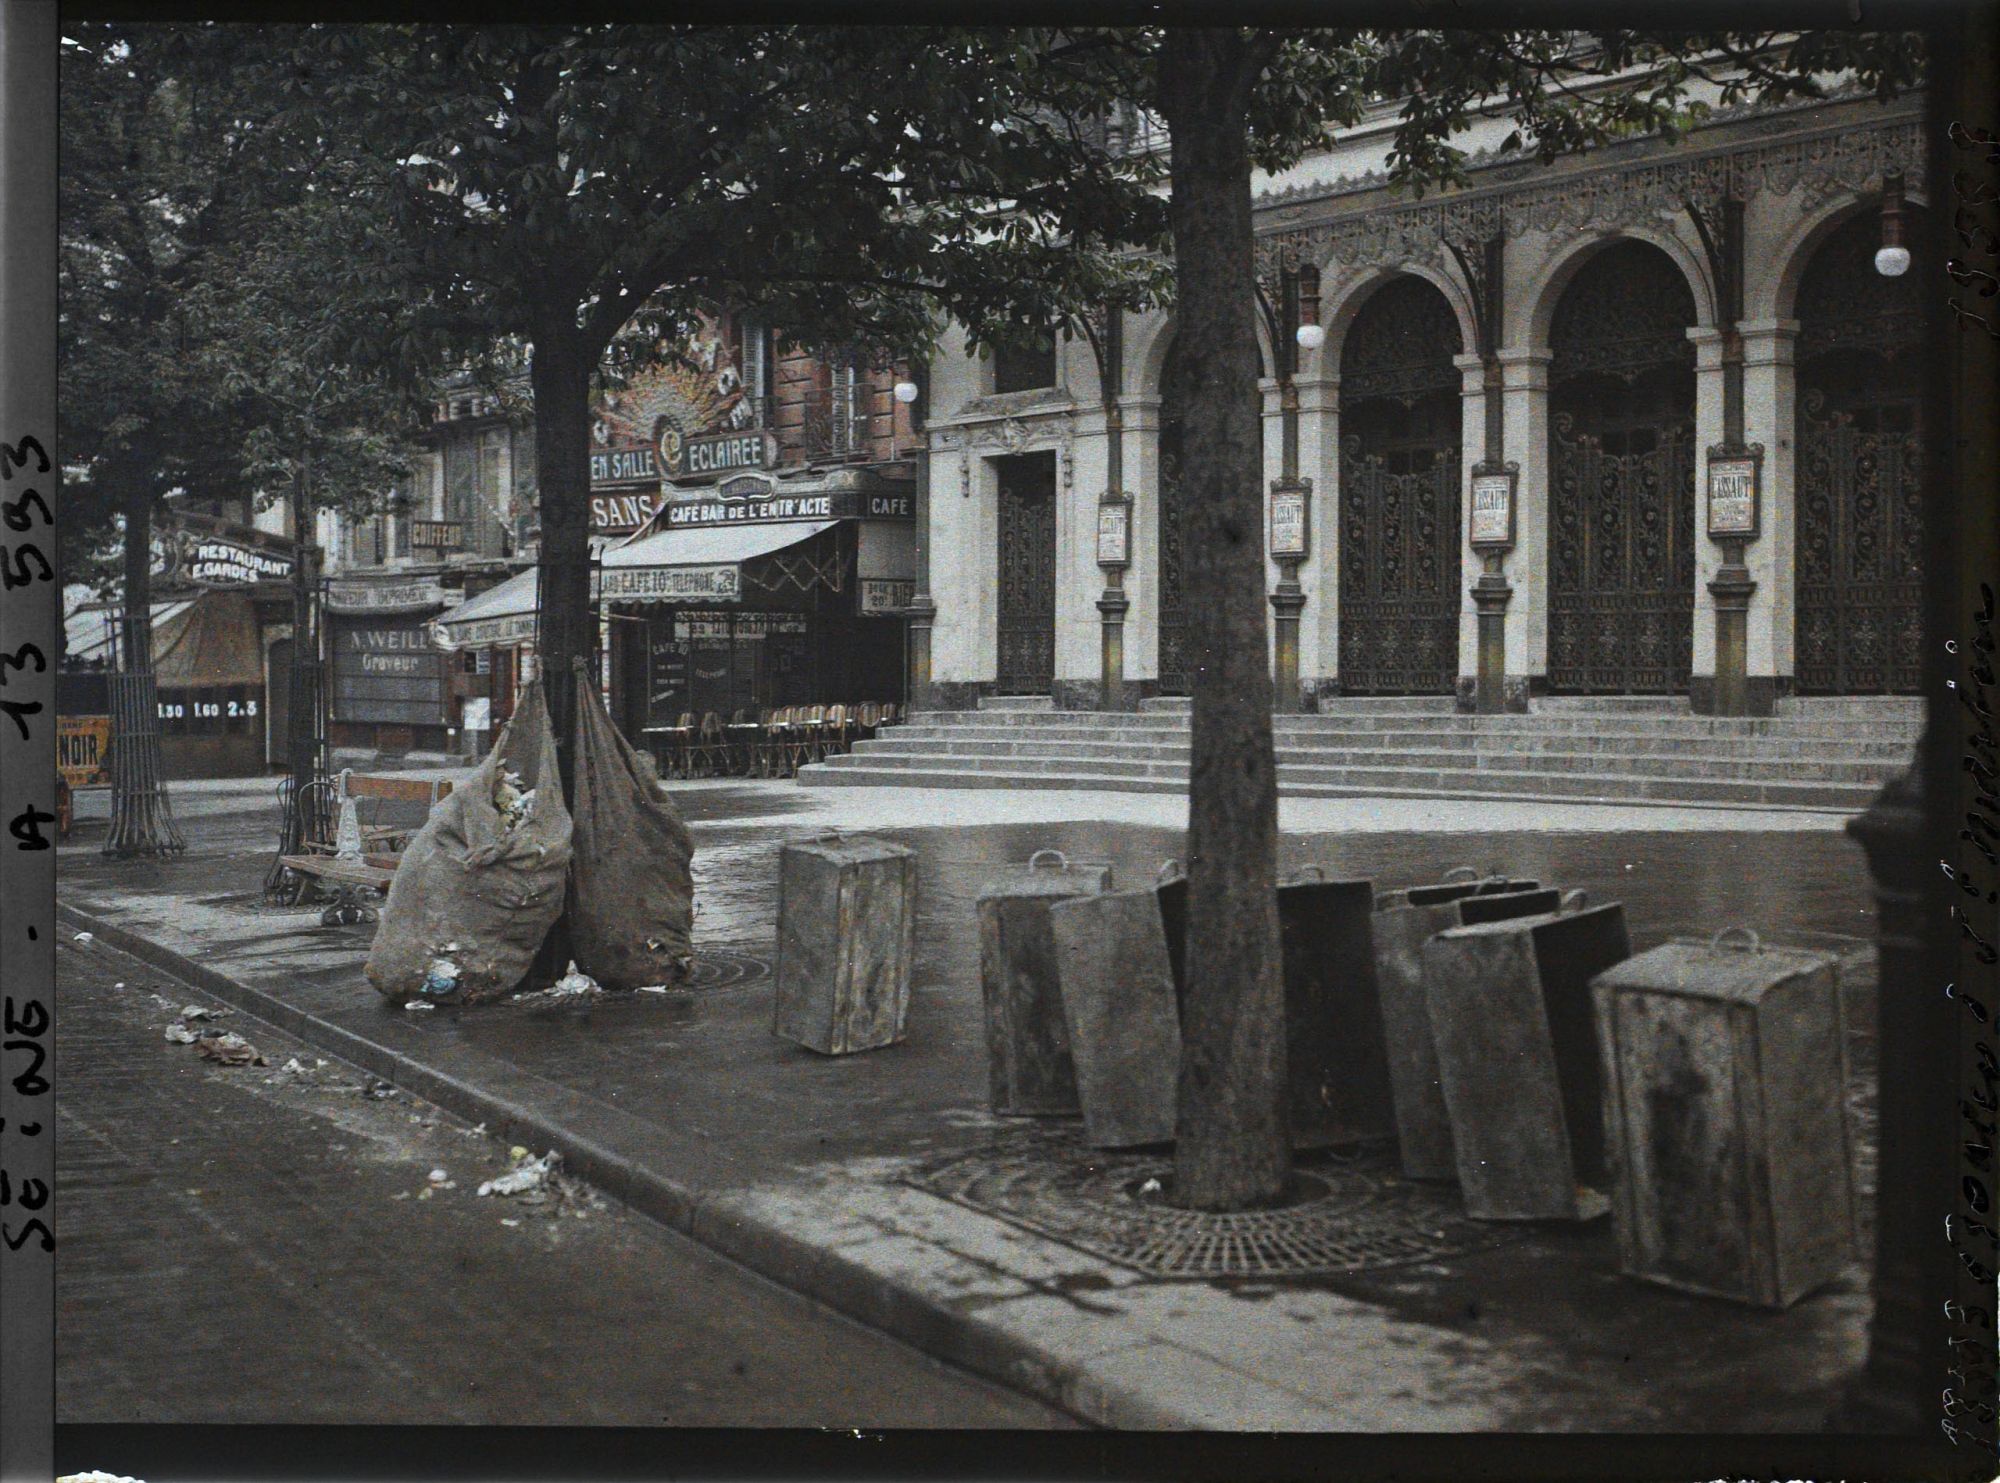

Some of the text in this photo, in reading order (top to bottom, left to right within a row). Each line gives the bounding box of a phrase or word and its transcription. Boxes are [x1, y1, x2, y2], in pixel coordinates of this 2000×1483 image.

[612, 451, 655, 478] SALLE
[690, 437, 761, 471] ECLAIREE
[592, 495, 653, 527] SANS
[701, 504, 725, 521] BAR
[729, 506, 745, 519] DE
[198, 545, 291, 576] RESTAURANT
[362, 653, 418, 672] Graveur
[59, 734, 98, 766] NOIR
